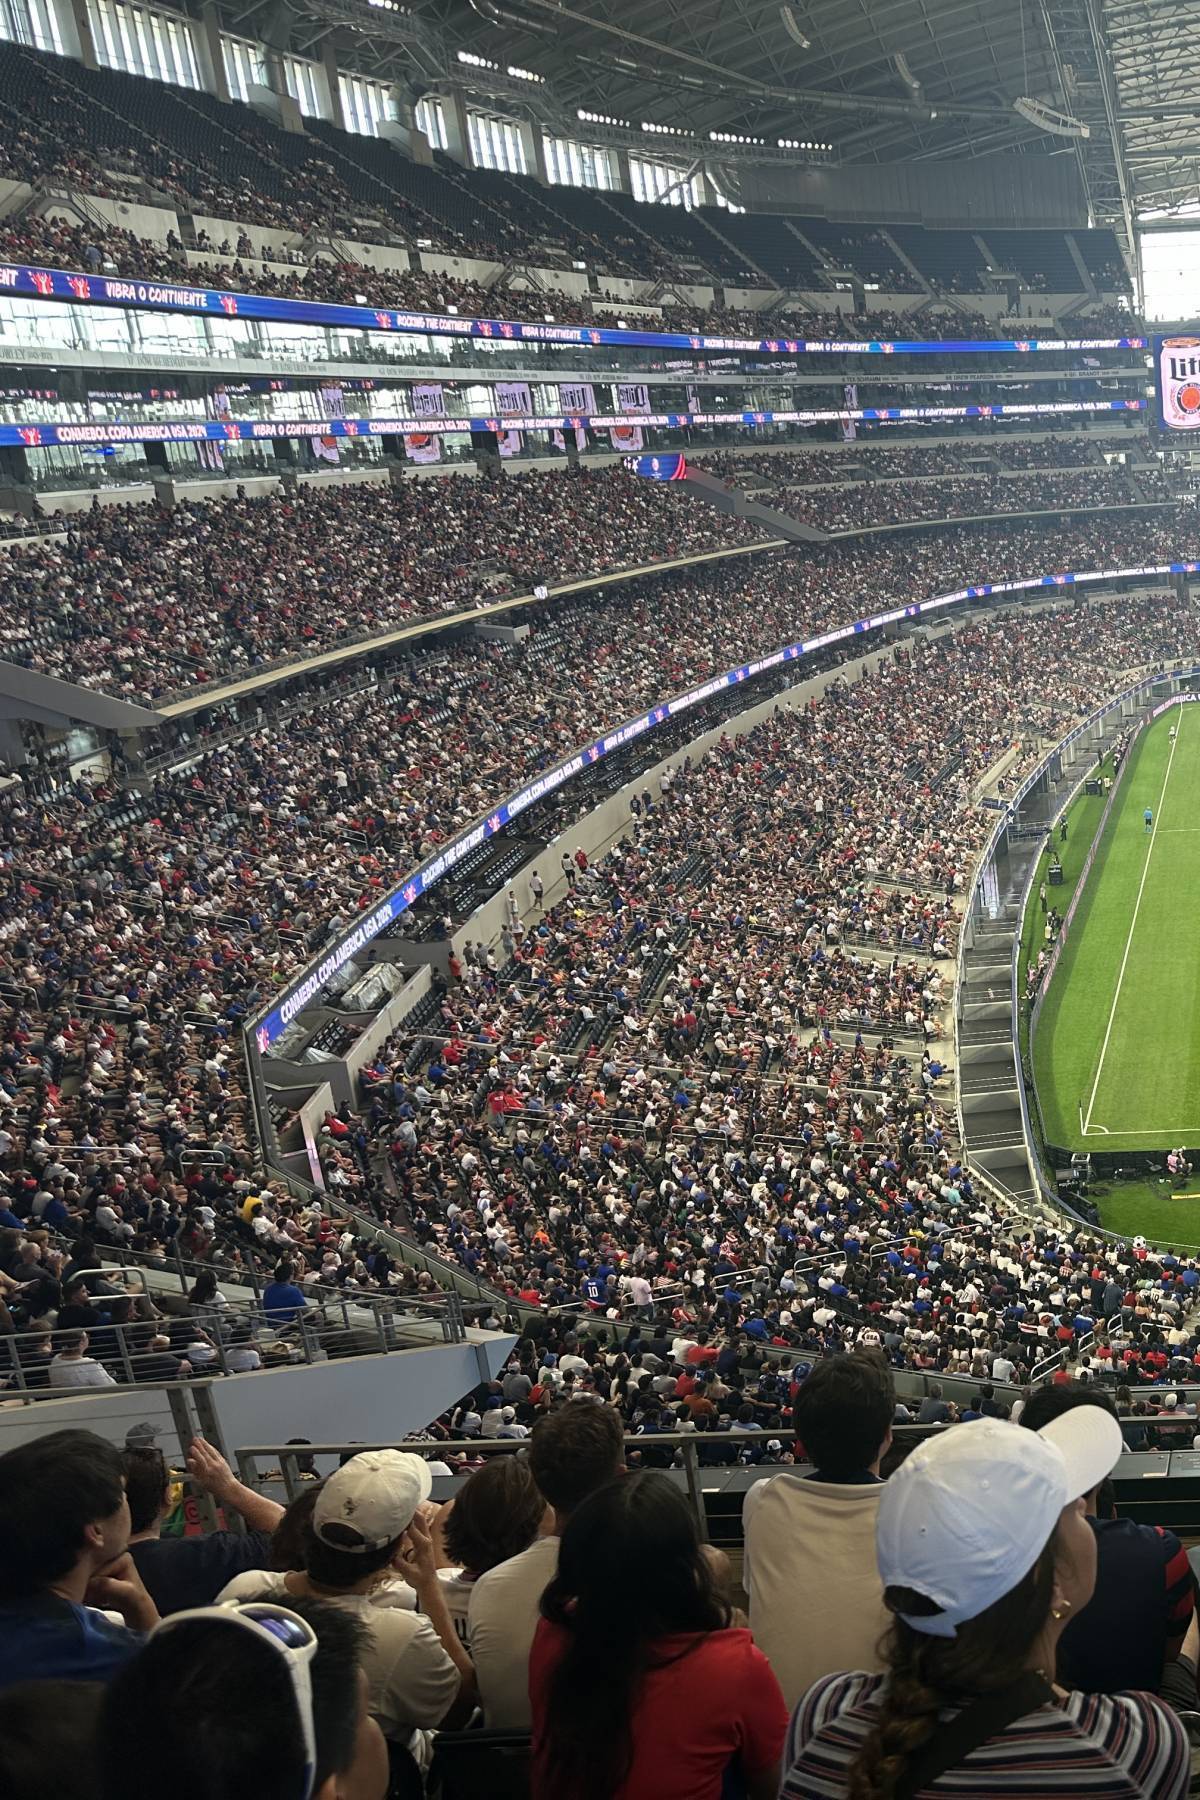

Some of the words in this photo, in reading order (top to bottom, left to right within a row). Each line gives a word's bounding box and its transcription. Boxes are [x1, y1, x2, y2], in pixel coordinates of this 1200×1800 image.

[106, 282, 136, 300] VIBRA
[138, 285, 147, 301] O
[149, 287, 207, 307] CONTINENTE
[398, 315, 424, 327] ROCKING
[425, 317, 439, 328] THE
[440, 319, 472, 332] CONTINENT
[522, 326, 539, 337] VIBRA
[540, 328, 544, 337] O
[546, 328, 581, 339] CONTINENTE
[253, 424, 276, 436] VIBRA
[278, 424, 284, 435] O
[286, 423, 331, 435] CONTINENTE
[369, 422, 402, 433] CONMEBOL
[403, 421, 418, 432] COPA
[418, 421, 444, 431] AMERICA
[446, 420, 456, 430] USA
[456, 420, 471, 430] 2024
[502, 420, 523, 428] ROCKING
[524, 420, 534, 428] THE
[536, 419, 564, 428] CONTINENT
[58, 427, 107, 441] CONMEBOL
[108, 426, 130, 440] COPA
[129, 426, 171, 439] AMERICA
[172, 425, 188, 438] USA
[189, 425, 207, 438] 2024
[421, 858, 445, 887] ROCKING
[455, 824, 485, 859] CONTINENT
[280, 978, 321, 1023] CONMEBOL
[319, 960, 339, 988] COPA
[334, 933, 366, 976] AMERICA
[364, 920, 379, 944] USA
[377, 904, 392, 929] 2024
[588, 1286, 598, 1298] 10
